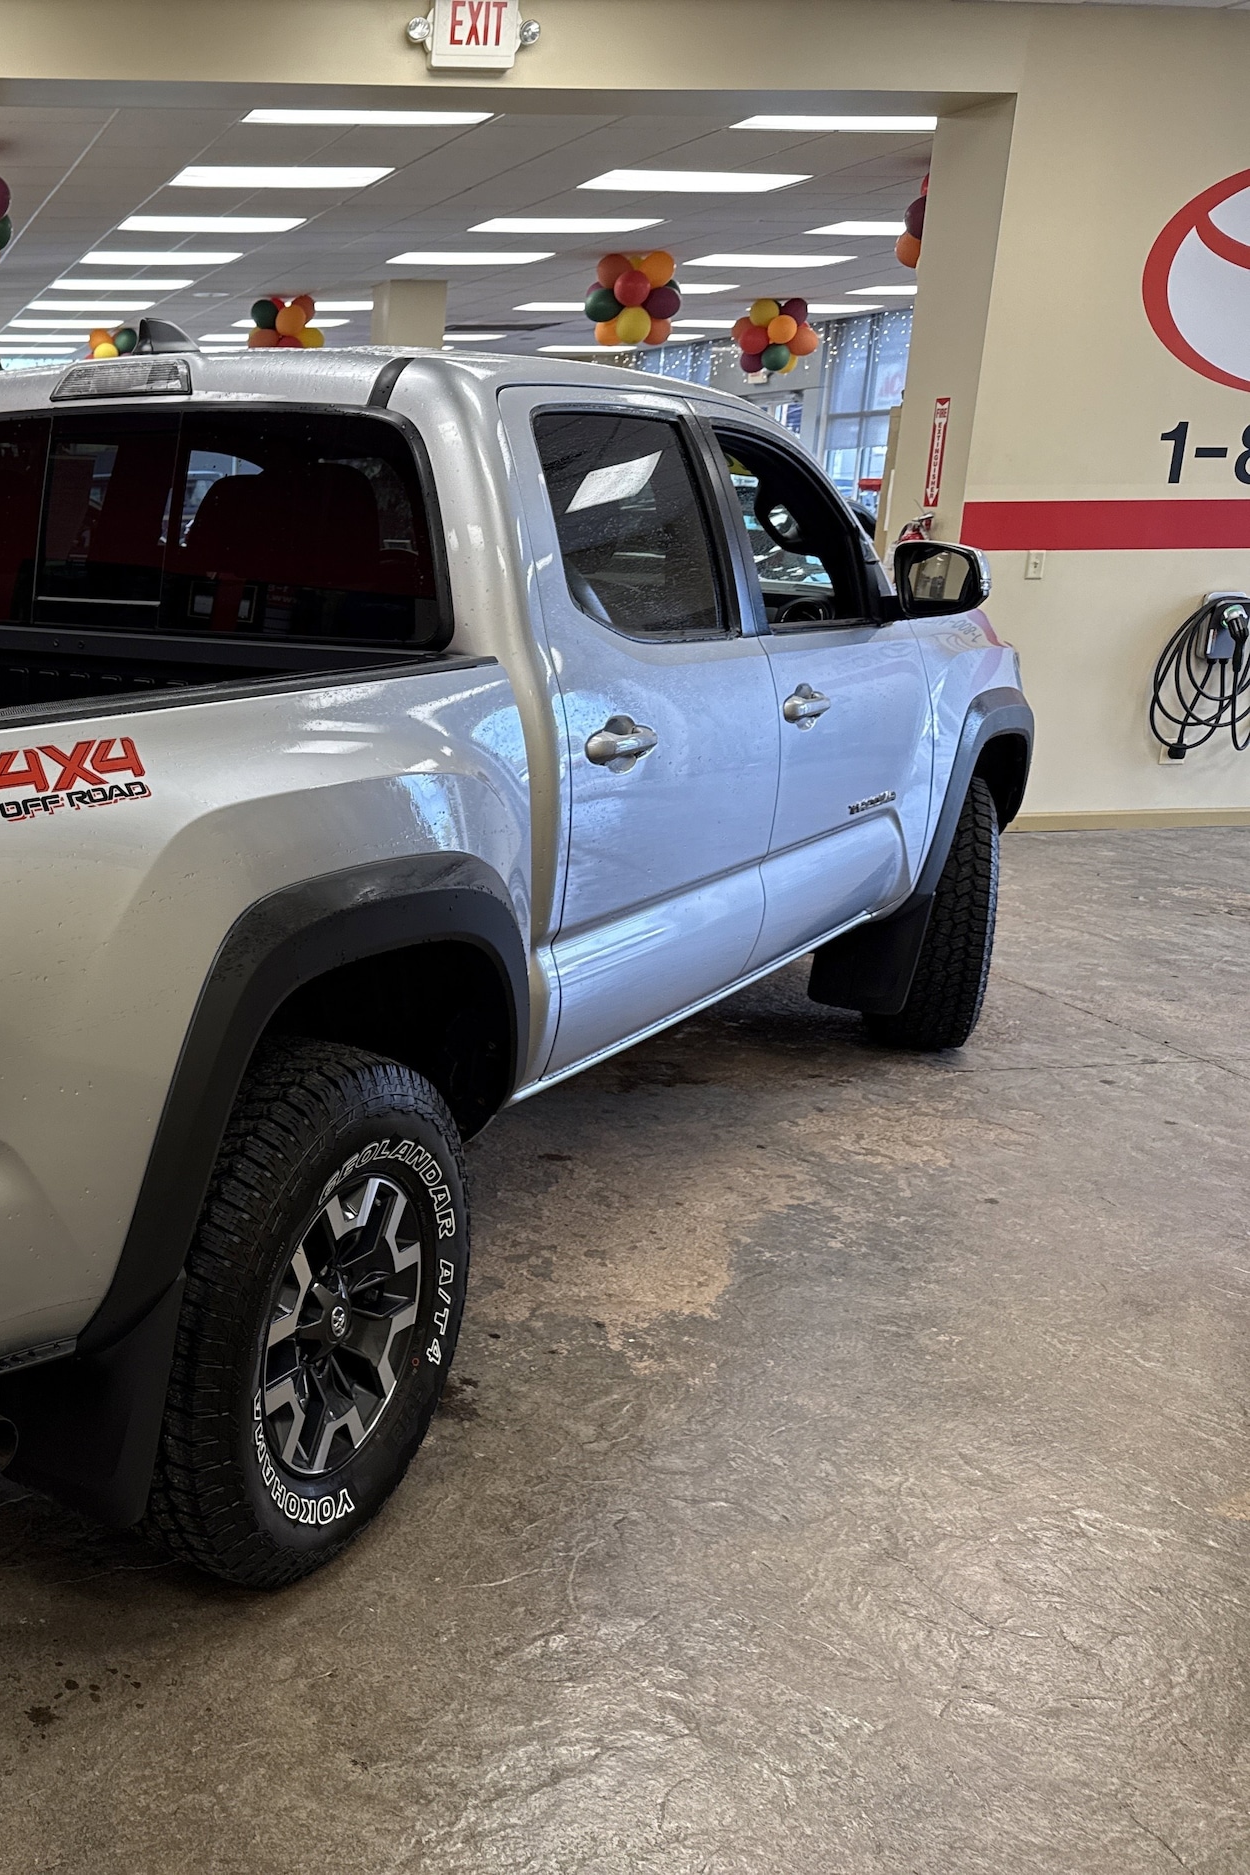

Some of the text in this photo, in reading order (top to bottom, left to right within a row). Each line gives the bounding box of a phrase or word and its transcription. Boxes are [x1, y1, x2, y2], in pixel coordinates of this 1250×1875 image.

[449, 1, 507, 46] EXIT
[936, 408, 948, 418] FIRE
[929, 422, 942, 499] EXTINGUISHER
[0, 781, 152, 822] OFF ROAD
[318, 1139, 456, 1239] GEOLANDAR
[254, 1388, 355, 1525] YOKOHAMA
